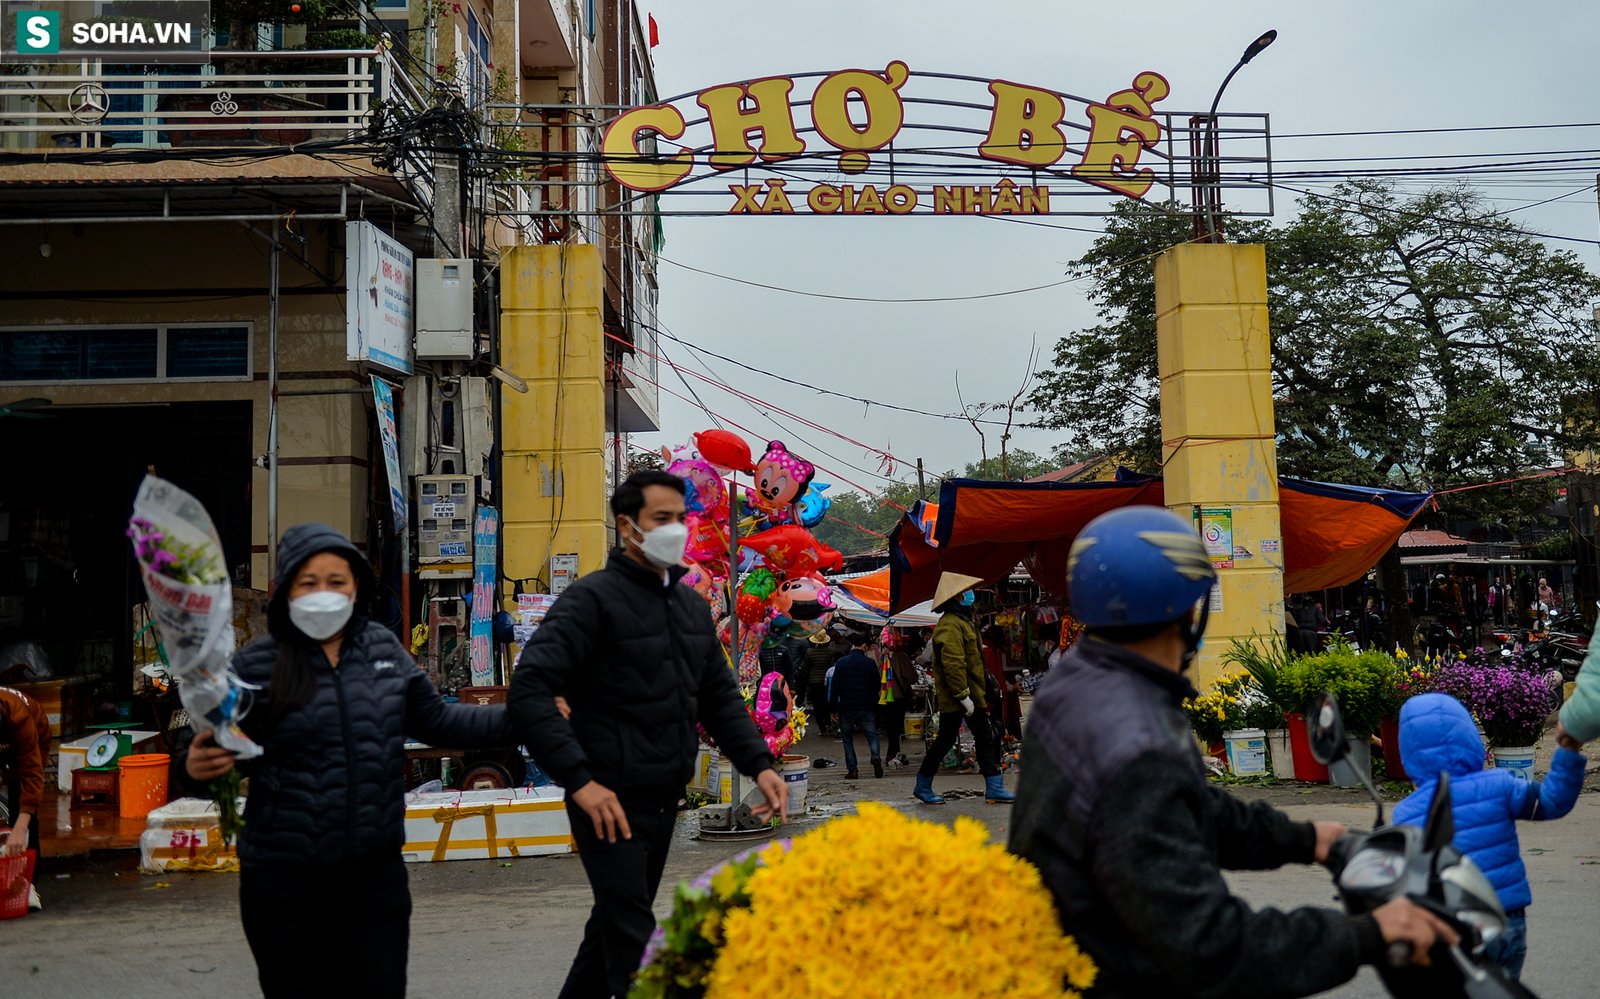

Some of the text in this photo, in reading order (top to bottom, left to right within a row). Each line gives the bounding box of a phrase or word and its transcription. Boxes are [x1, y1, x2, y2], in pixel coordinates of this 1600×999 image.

[601, 60, 1170, 199] CHỢ BỂ
[727, 178, 1050, 214] XÃ GIAO NHÂN
